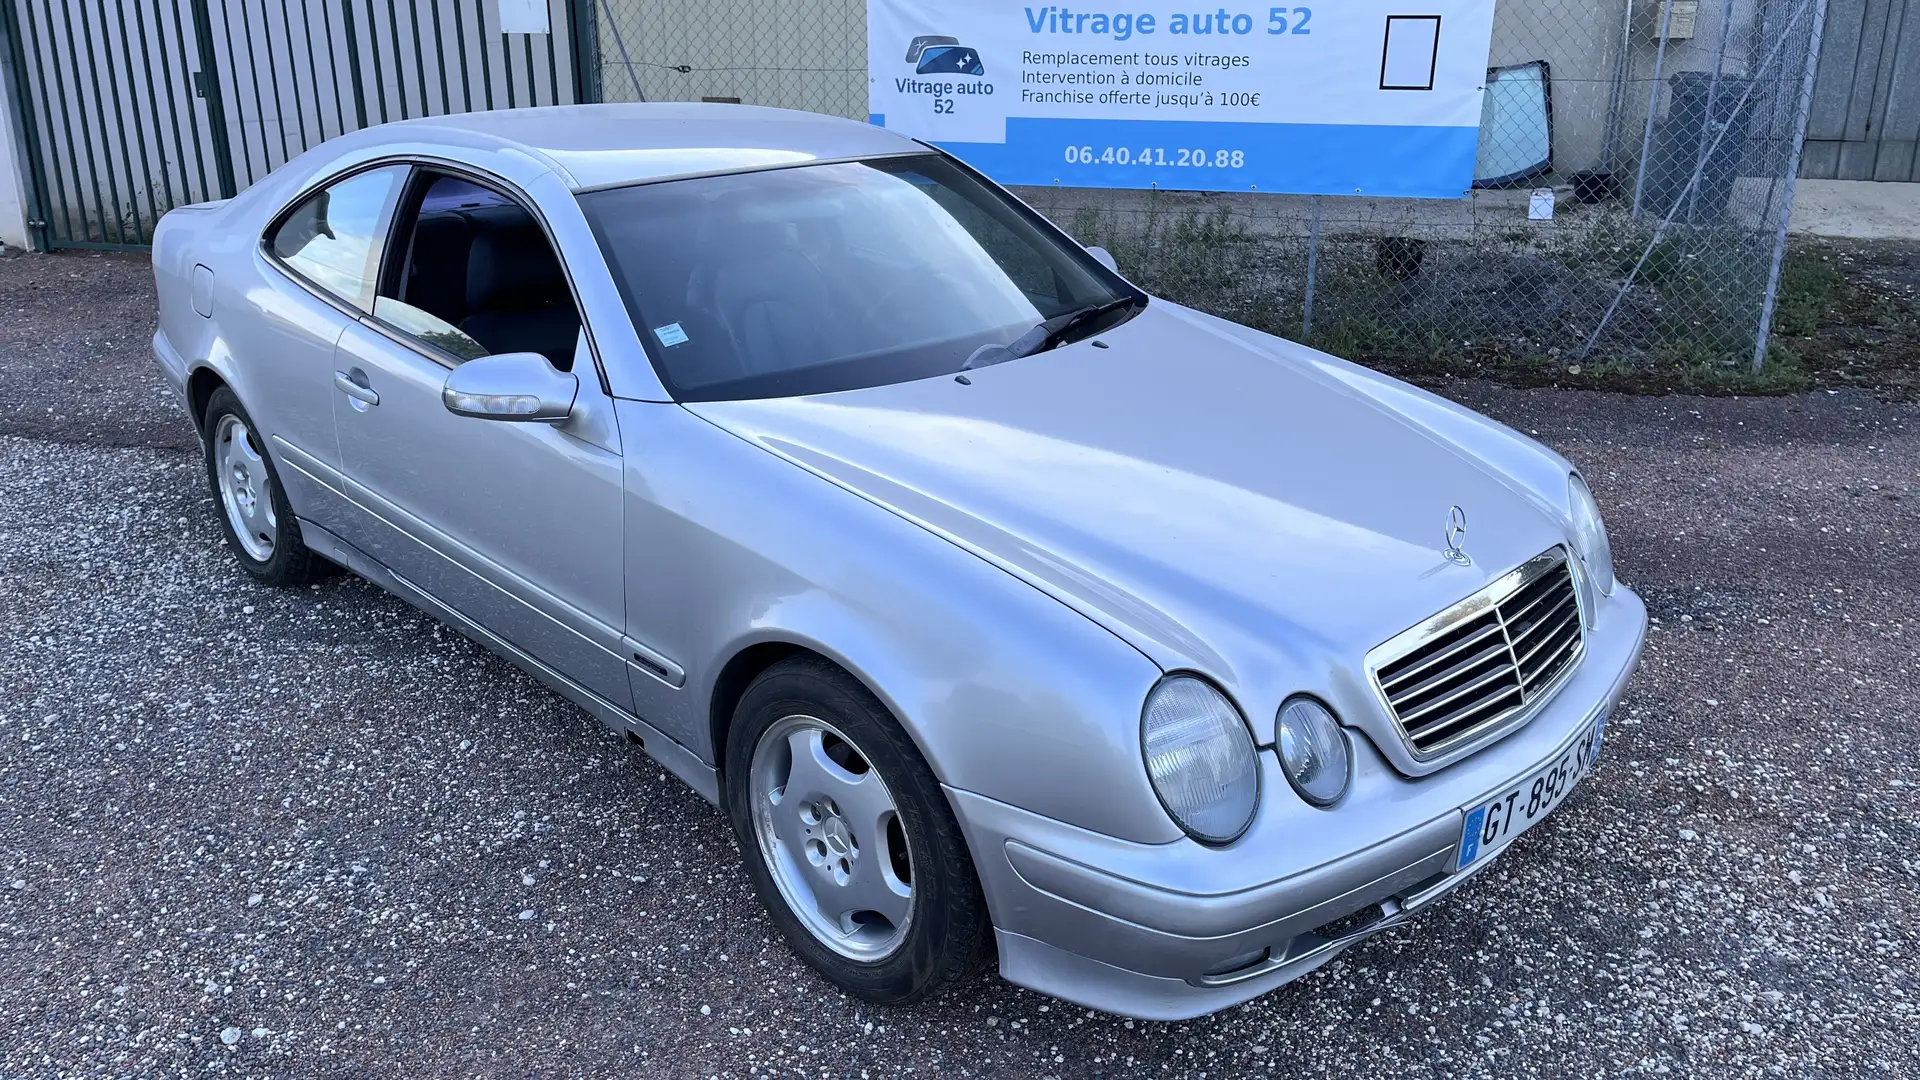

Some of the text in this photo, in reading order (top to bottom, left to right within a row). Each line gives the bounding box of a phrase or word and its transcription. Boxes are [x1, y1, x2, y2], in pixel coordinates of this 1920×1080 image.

[1024, 7, 1312, 41] Vitrage auto 52
[1022, 51, 1250, 70] Remplacement tous vitrages
[1022, 70, 1202, 86] Intervention à domicile
[895, 78, 994, 98] Vitrage auto
[934, 99, 954, 114] 52
[1022, 89, 1094, 104] Franchise
[1099, 90, 1151, 105] offerte
[1220, 92, 1261, 107] 100€
[1064, 146, 1245, 168] 06.40.41.20.88
